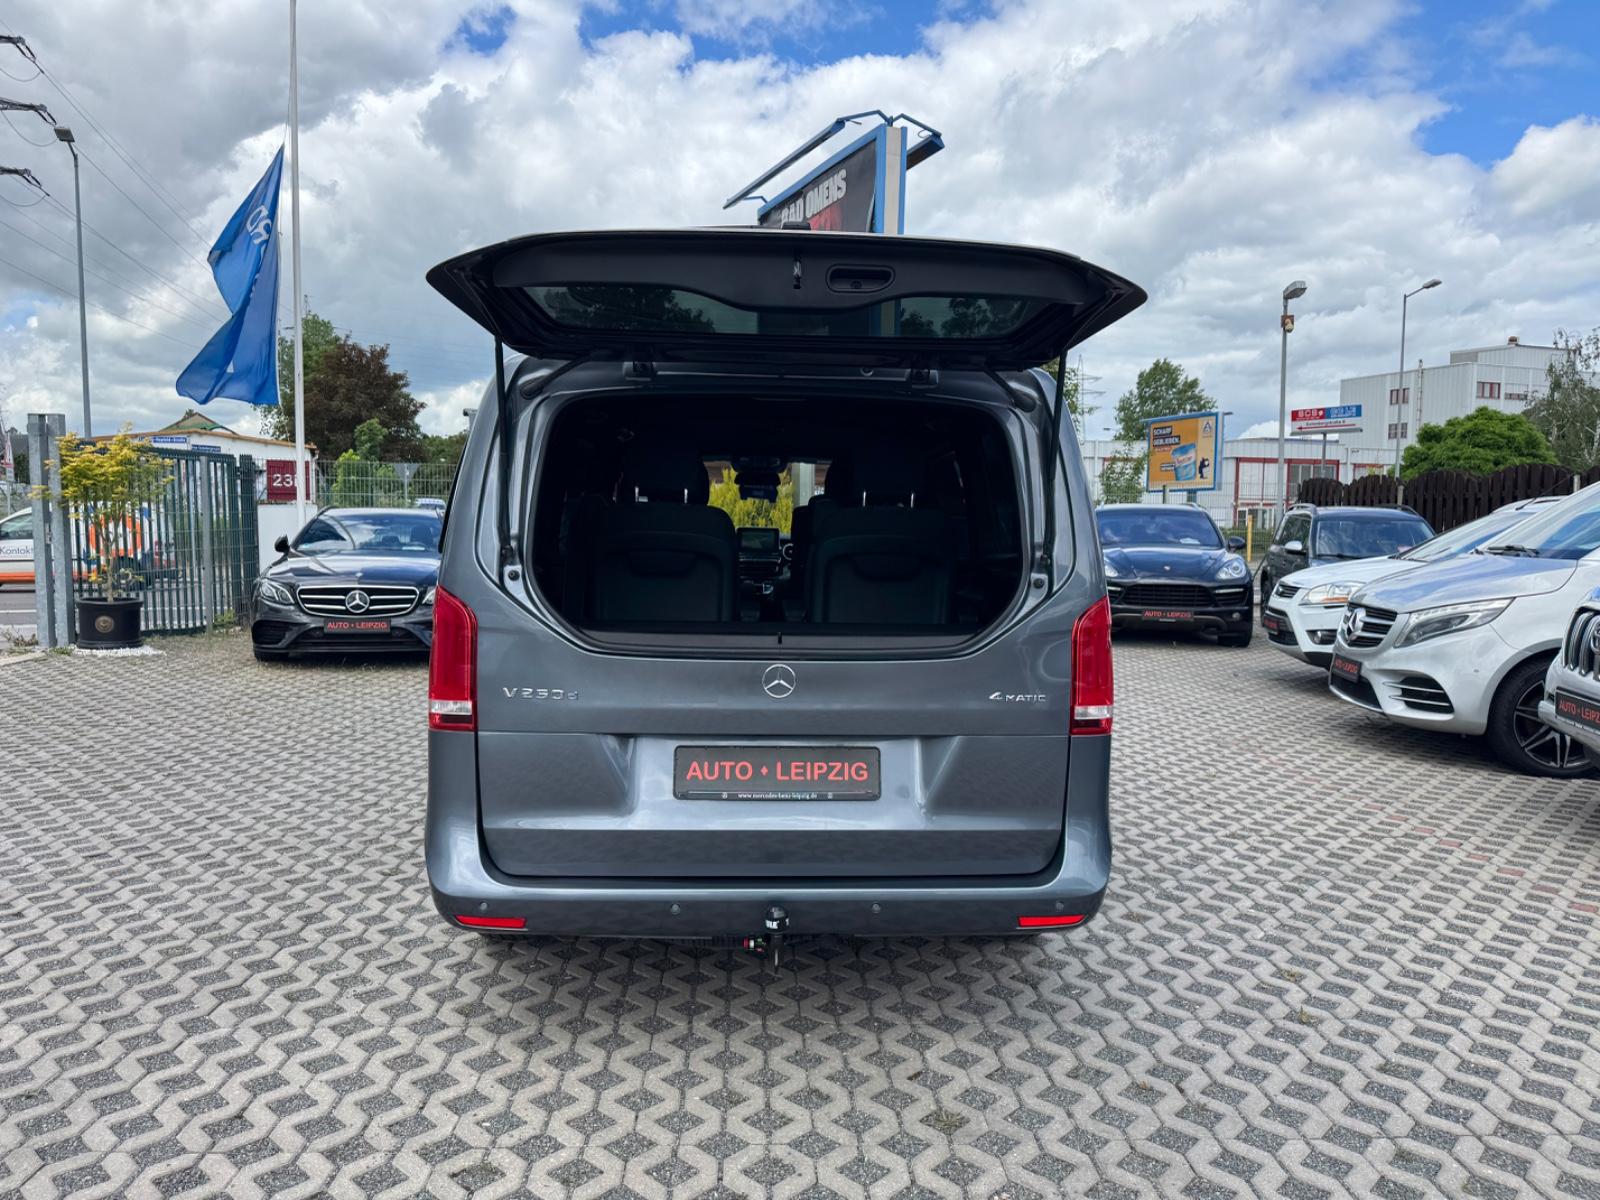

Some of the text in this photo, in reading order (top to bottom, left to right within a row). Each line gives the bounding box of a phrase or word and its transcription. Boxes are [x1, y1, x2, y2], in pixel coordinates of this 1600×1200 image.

[806, 169, 847, 218] OMENS
[327, 621, 388, 629] AUTO LEIPZIG
[1558, 701, 1577, 715] AUTO
[686, 760, 869, 782] AUTO LEIPZIG
